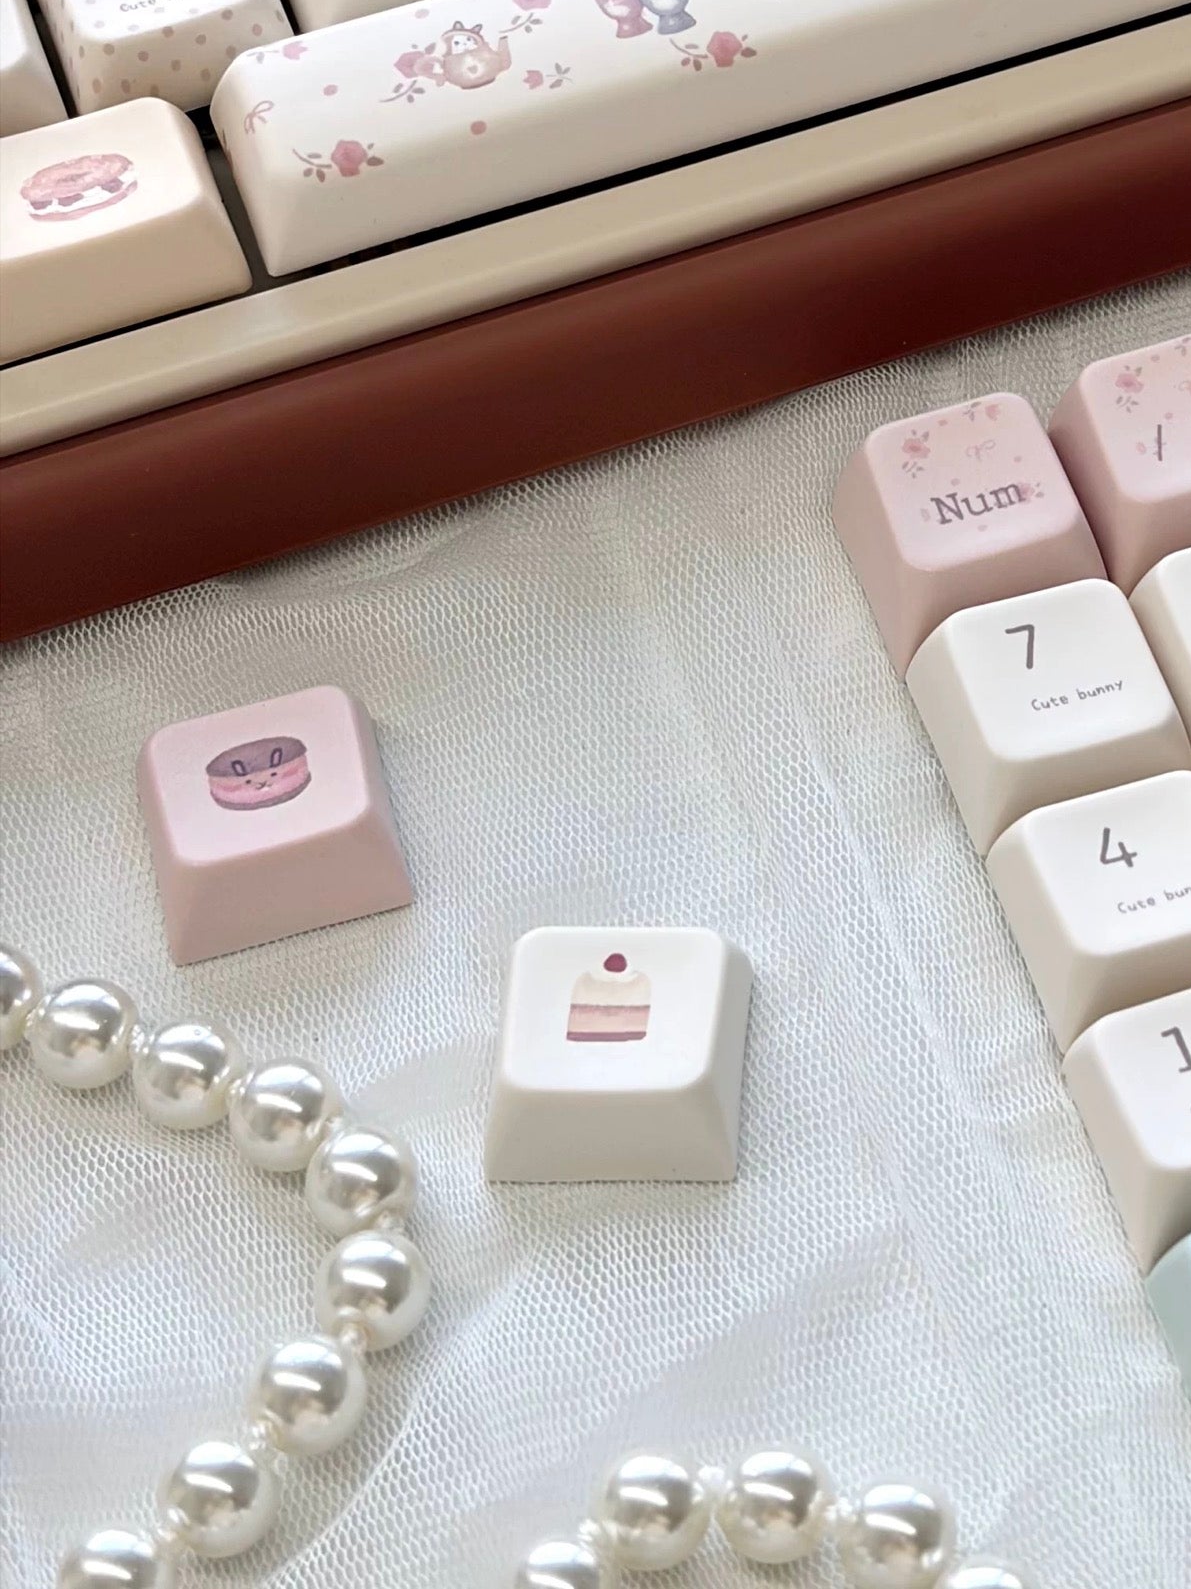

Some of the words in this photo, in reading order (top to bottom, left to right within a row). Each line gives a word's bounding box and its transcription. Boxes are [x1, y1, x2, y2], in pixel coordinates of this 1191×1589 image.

[930, 482, 1027, 525] Num
[1005, 625, 1036, 669] 7
[1031, 695, 1069, 711] Cute
[1076, 681, 1123, 700] bunny
[1099, 827, 1138, 868] 4
[1118, 894, 1156, 914] Cute
